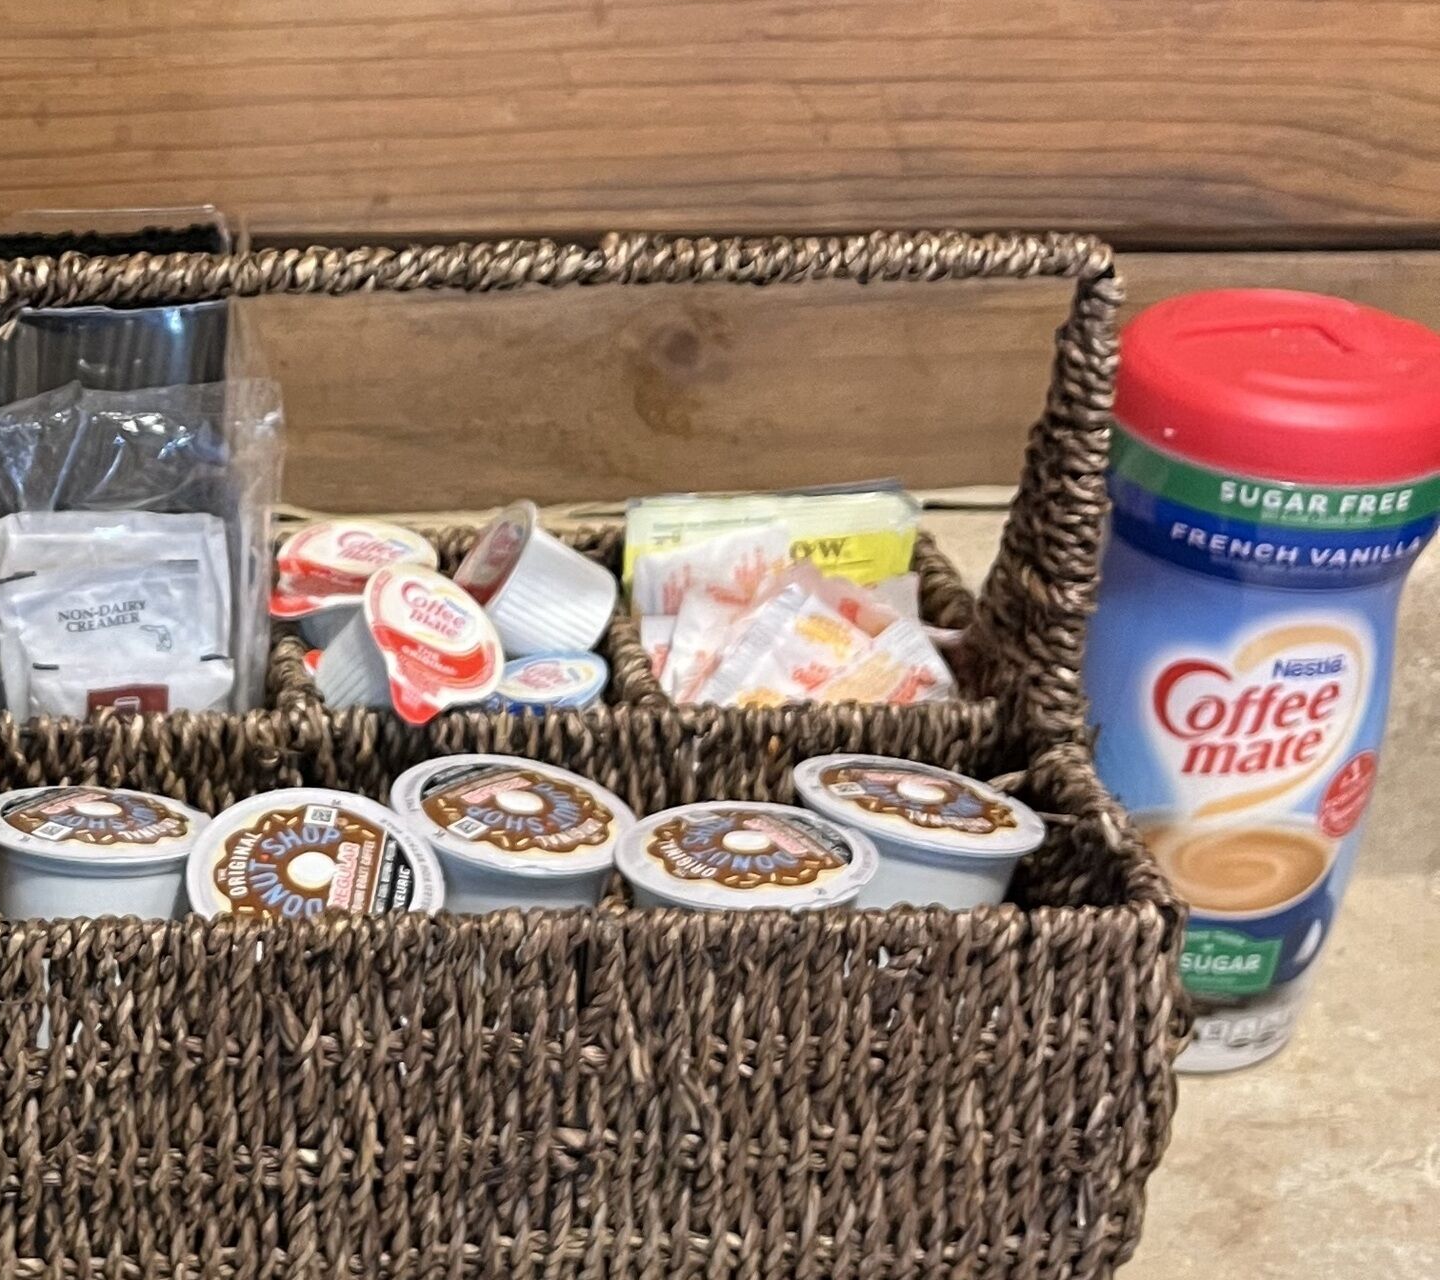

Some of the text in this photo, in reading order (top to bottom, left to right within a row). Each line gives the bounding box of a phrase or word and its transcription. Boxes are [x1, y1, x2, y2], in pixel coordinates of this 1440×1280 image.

[1219, 480, 1415, 515] SUGAR FREE
[1169, 520, 1301, 566] FRENCH
[57, 599, 148, 624] NON-DAIRY
[65, 611, 140, 633] CREAMER
[1152, 658, 1343, 741] Coffee
[1181, 726, 1324, 775] mate
[227, 831, 264, 898] ORIGINAL
[248, 824, 343, 919] DONUT SHOP
[659, 840, 719, 879] ORIGINAL
[1179, 952, 1262, 974] SUGAR
